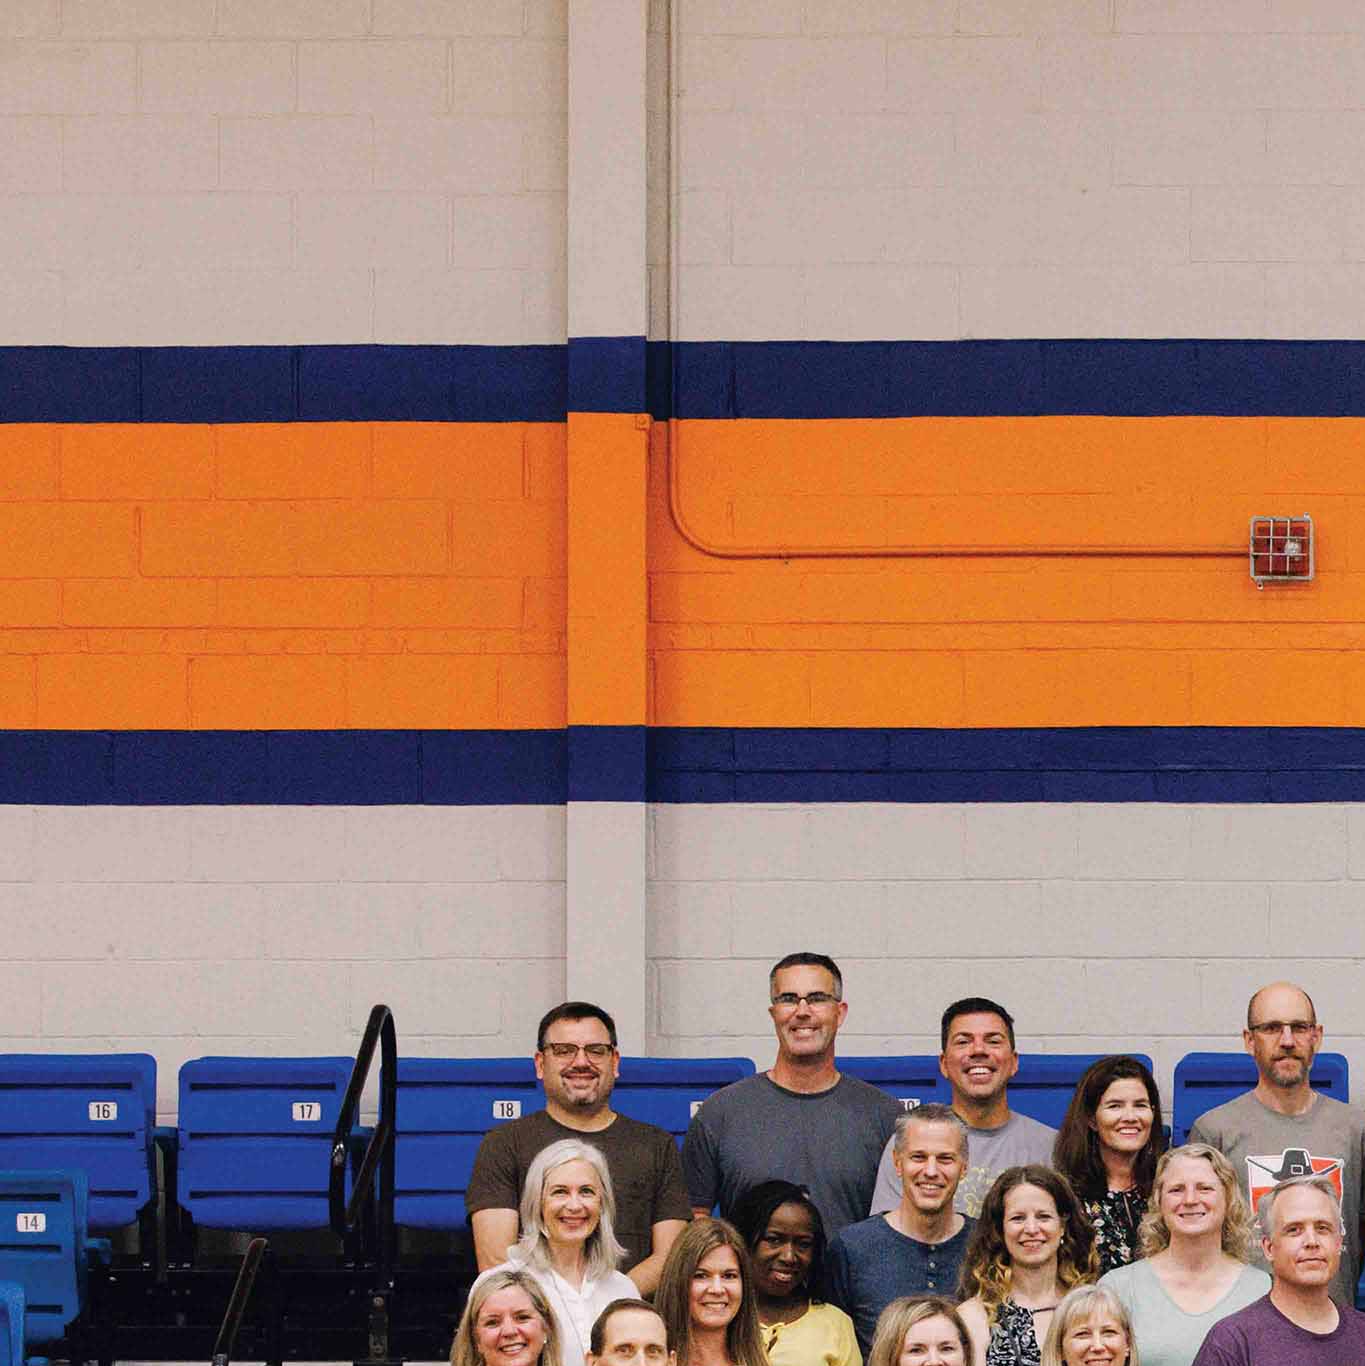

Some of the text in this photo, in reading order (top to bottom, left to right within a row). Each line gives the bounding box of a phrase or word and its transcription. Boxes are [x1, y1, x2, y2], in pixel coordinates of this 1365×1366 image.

[95, 1103, 111, 1119] 16
[300, 1103, 313, 1119] 17
[499, 1101, 515, 1119] 18
[23, 1215, 39, 1230] 14
